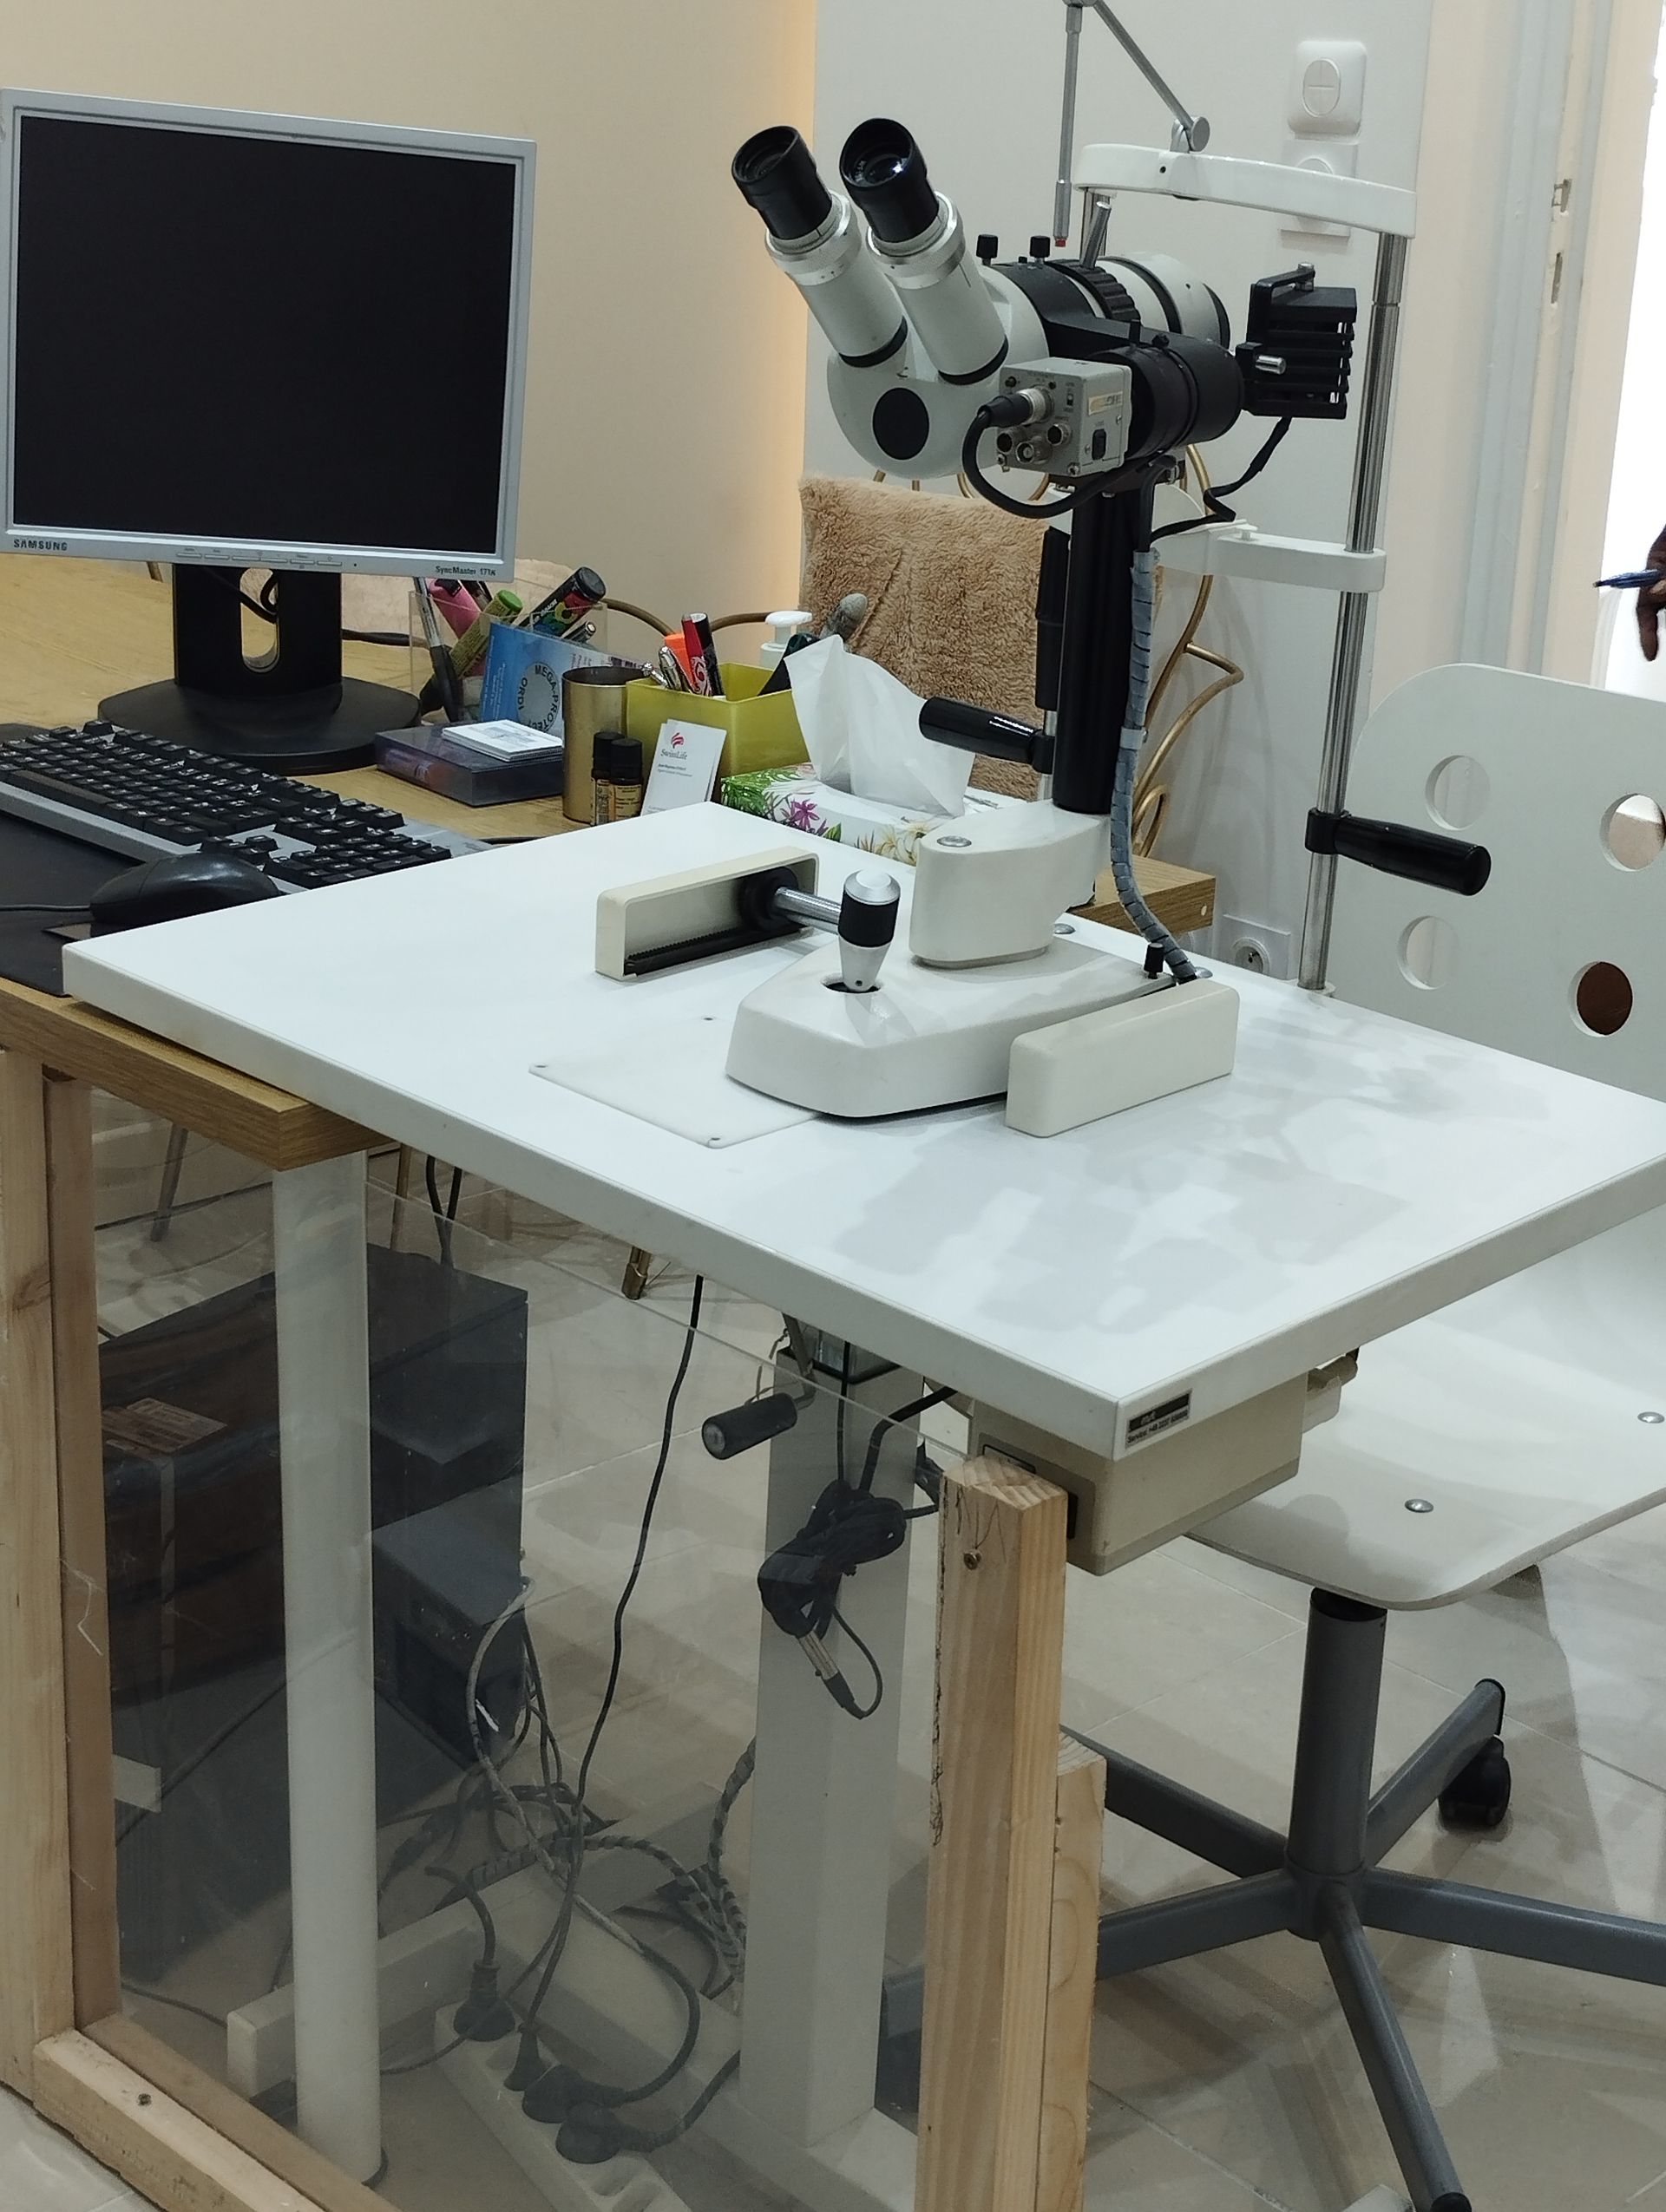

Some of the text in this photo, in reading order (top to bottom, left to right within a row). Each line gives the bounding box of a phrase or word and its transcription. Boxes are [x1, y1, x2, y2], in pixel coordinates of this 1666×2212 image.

[13, 539, 68, 551] SAMSUNG
[436, 566, 476, 575] SyncMaster
[517, 677, 528, 710] ORDI
